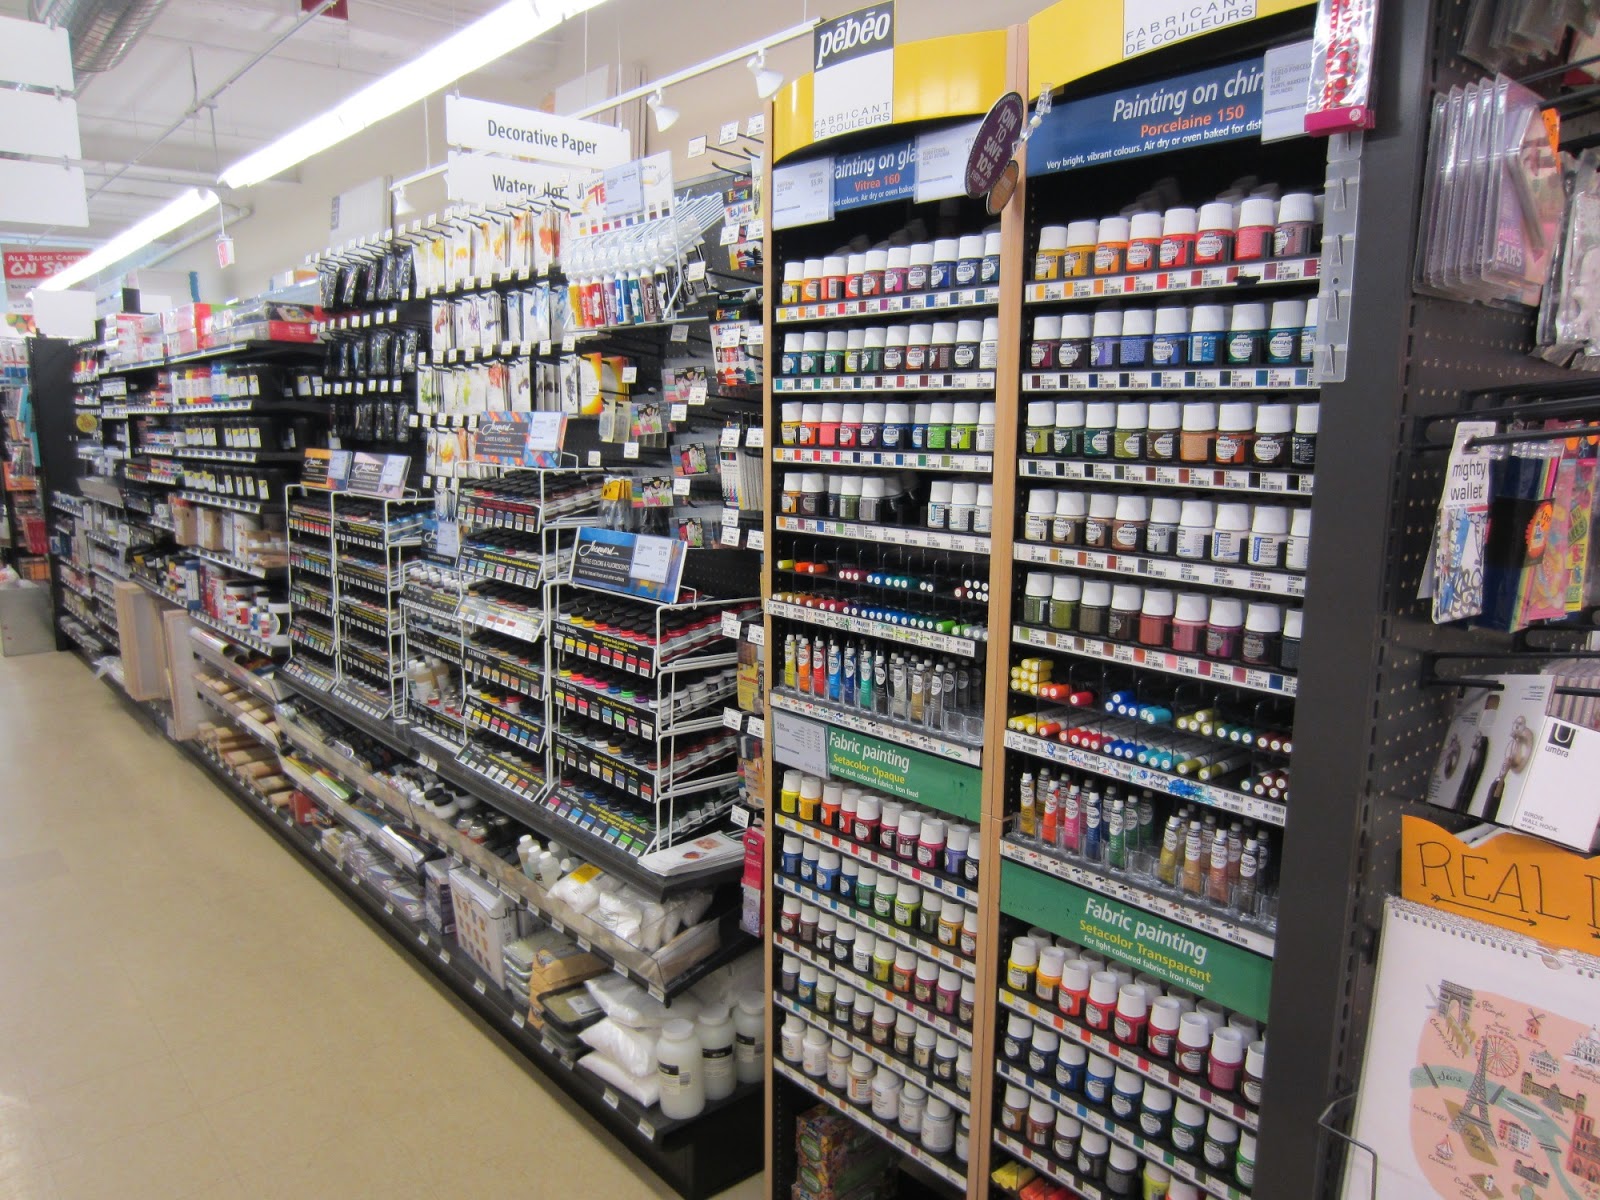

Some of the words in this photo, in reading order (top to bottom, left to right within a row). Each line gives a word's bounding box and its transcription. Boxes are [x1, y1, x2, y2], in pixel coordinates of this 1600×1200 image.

[1125, 0, 1249, 42] FABRICAN
[1125, 40, 1145, 55] DE
[1152, 5, 1253, 43] COULEURS
[1112, 88, 1187, 122] Painting
[1192, 84, 1217, 105] on
[1223, 67, 1264, 98] chin
[815, 102, 890, 128] FABRICANT
[815, 128, 827, 139] DE
[830, 112, 890, 135] COULEURS
[997, 105, 1018, 132] JOIN
[1140, 114, 1211, 138] Porcelaine
[1217, 105, 1245, 123] 150
[488, 119, 558, 149] Decorative
[562, 133, 597, 156] Paper
[995, 124, 1007, 143] TO
[1046, 160, 1061, 170] Very
[1062, 155, 1085, 167] bright,
[1086, 149, 1112, 162] vibrant
[1113, 145, 1142, 157] colours.
[1143, 141, 1155, 151] Air
[1157, 139, 1170, 150] dry
[1171, 137, 1180, 145] or
[1182, 133, 1201, 144] oven
[1204, 128, 1229, 140] baked
[1231, 124, 1244, 134] for
[834, 155, 876, 179] ainting
[879, 152, 894, 169] on
[898, 143, 916, 171] gla
[984, 136, 1004, 162] SAVE
[976, 153, 995, 178] 10%
[855, 178, 880, 192] Vitrea
[884, 172, 901, 186] 160
[8, 254, 25, 262] ALL
[56, 254, 85, 262] CANVA
[10, 262, 37, 275] ON
[43, 262, 73, 274] SA
[1452, 461, 1486, 481] mighty
[1450, 484, 1483, 500] wallet
[829, 731, 860, 754] Fabric
[862, 745, 910, 773] painting
[1545, 745, 1569, 758] umbra
[833, 753, 871, 773] Setacolor
[872, 767, 905, 784] Opaque
[856, 771, 876, 784] coloured
[1521, 816, 1538, 828] WALL
[1540, 822, 1558, 833] HOOK
[1416, 841, 1571, 921] REAL
[1084, 897, 1133, 930] Fabric
[1135, 917, 1208, 965] painting
[1079, 919, 1133, 950] Setacolor
[1137, 942, 1212, 983] Transparent
[1084, 935, 1095, 945] For
[1096, 938, 1111, 953] light
[1111, 945, 1141, 965] coloured
[1142, 955, 1168, 976] fabrics.
[1169, 970, 1184, 984] Iron
[1185, 974, 1205, 991] fixed
